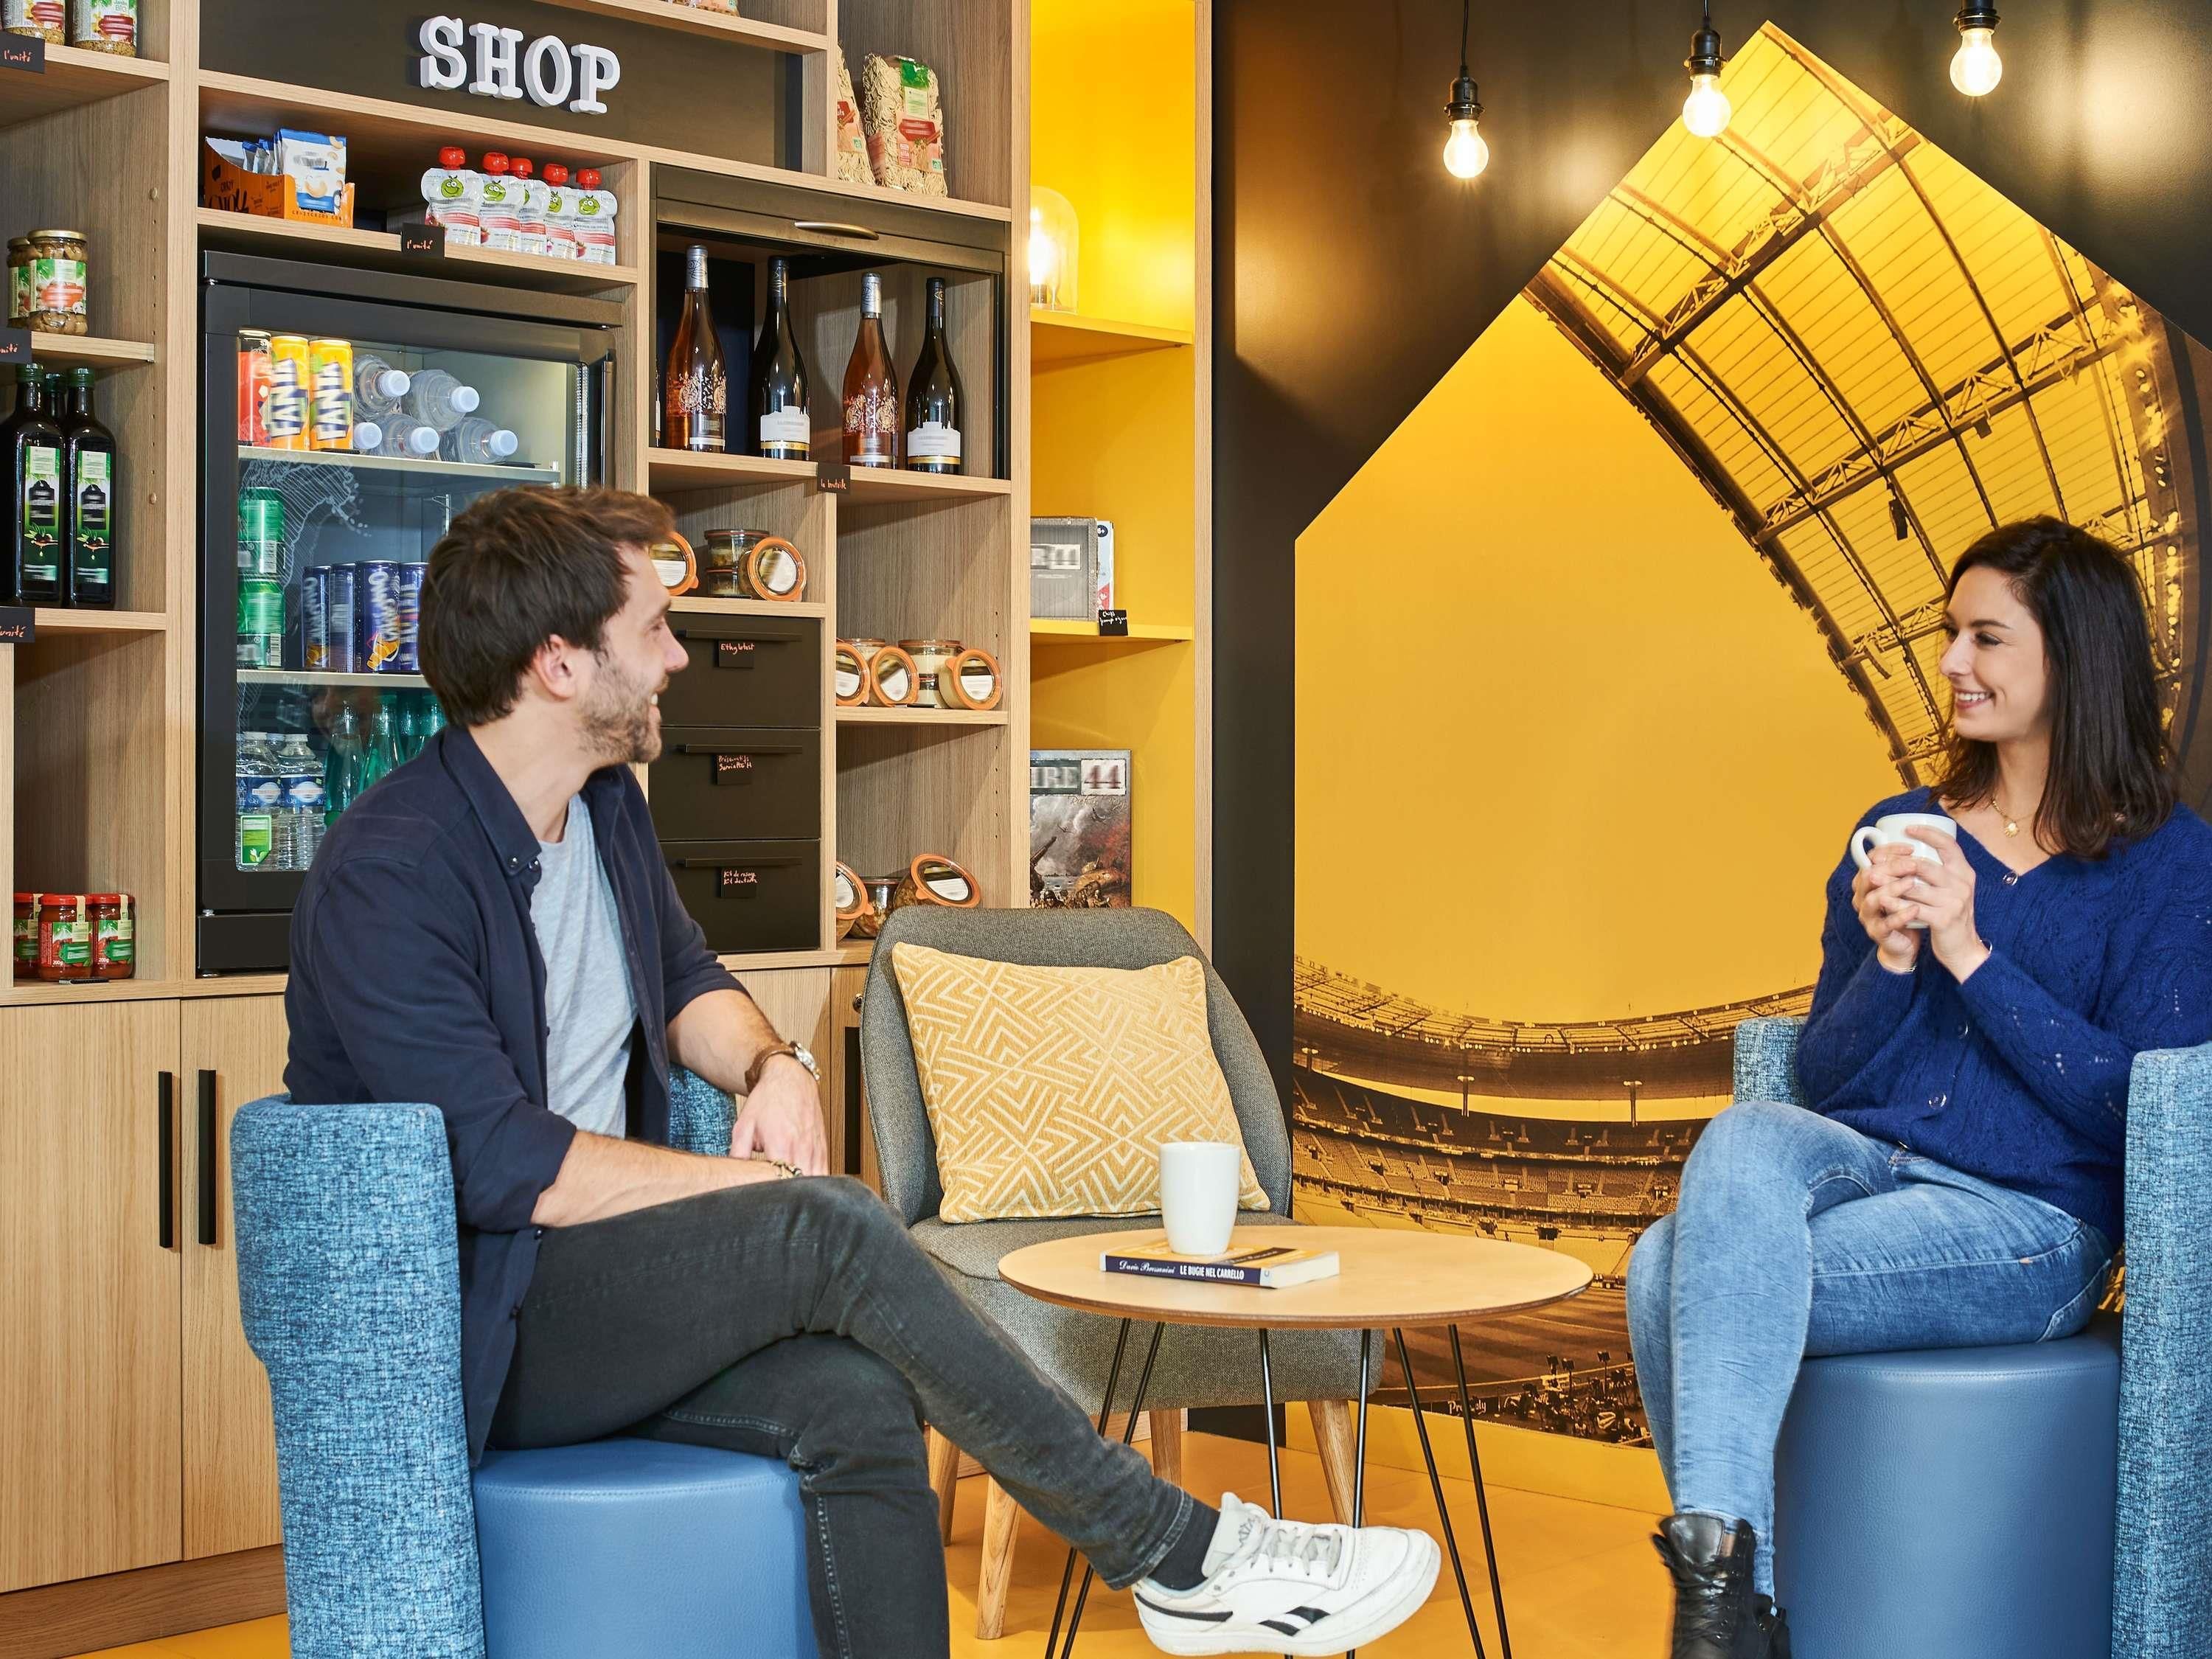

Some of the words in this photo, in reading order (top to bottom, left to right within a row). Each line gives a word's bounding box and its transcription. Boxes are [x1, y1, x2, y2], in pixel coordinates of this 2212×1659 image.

[4, 49, 32, 62] l'unité
[420, 15, 620, 114] SHOP
[406, 239, 433, 250] l'unité
[0, 343, 18, 353] nité
[1119, 1259, 1139, 1271] Dario
[1180, 1265, 1187, 1276] LE
[1188, 1265, 1205, 1276] BUGIE
[1205, 1267, 1217, 1279] NEL
[1217, 1267, 1245, 1281] CARRELLO
